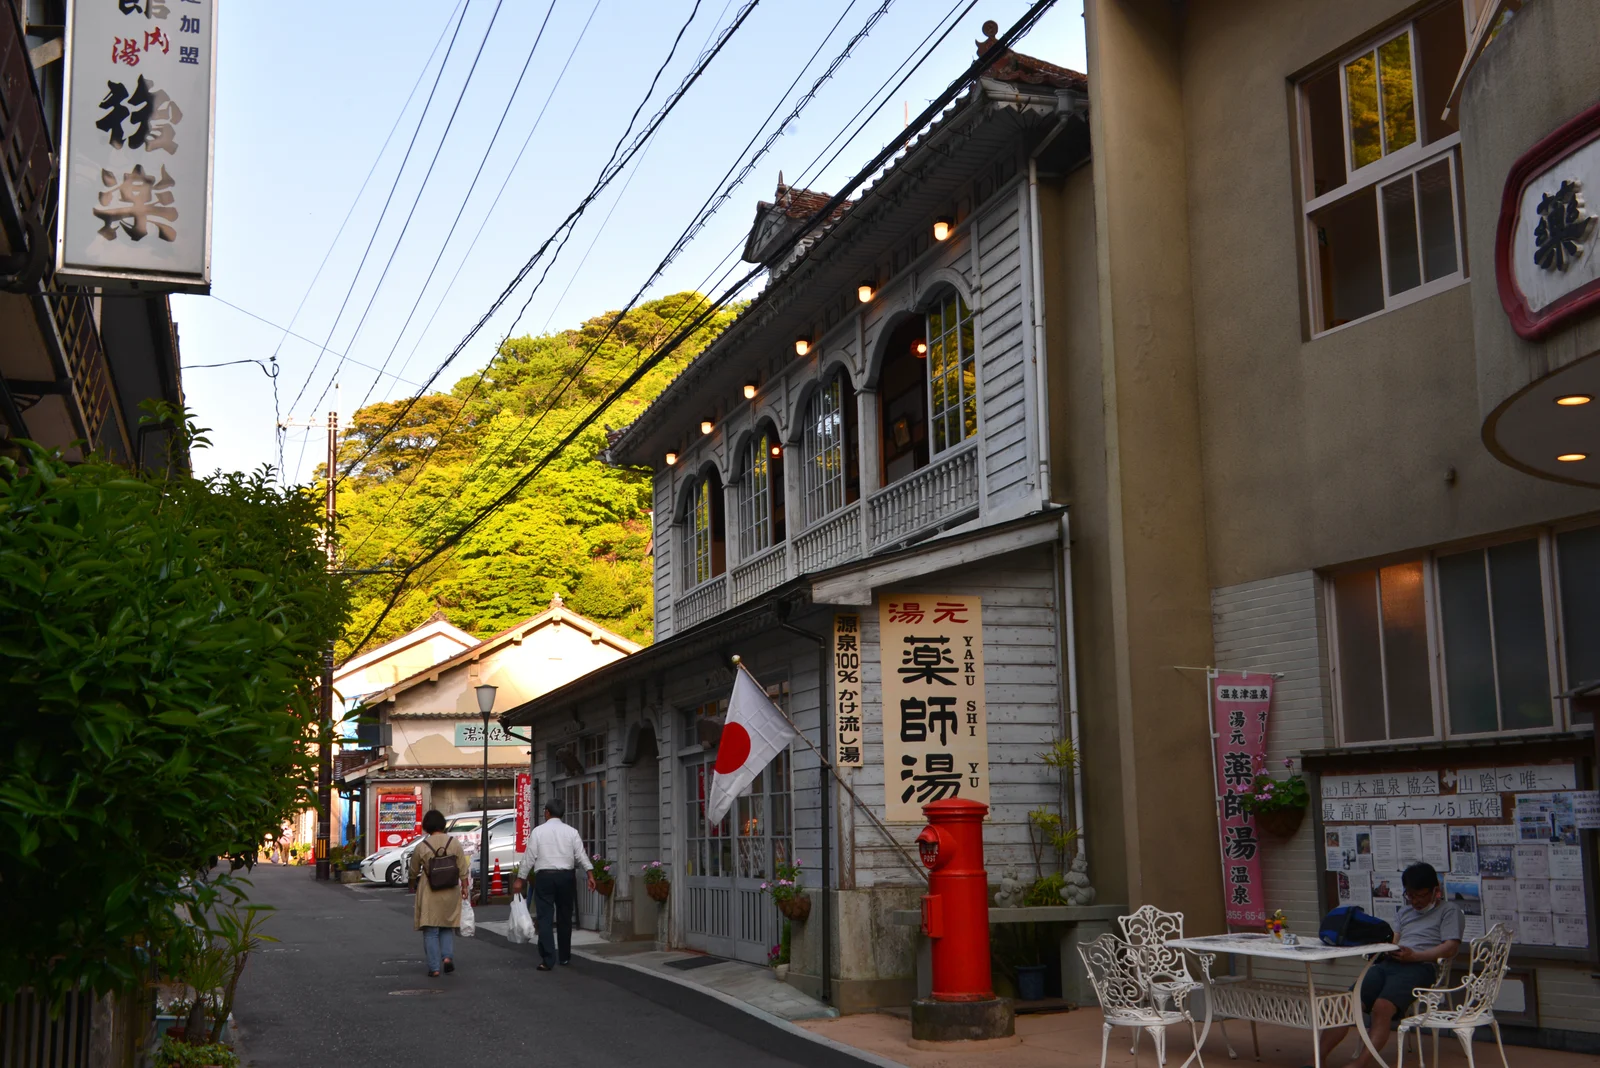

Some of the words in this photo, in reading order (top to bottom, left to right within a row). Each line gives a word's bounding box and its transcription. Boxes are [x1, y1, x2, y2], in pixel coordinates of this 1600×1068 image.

[179, 0, 201, 64] 加盟
[889, 602, 969, 624] 湯元
[963, 636, 976, 686] YAKU
[1220, 688, 1268, 700] 温泉津温泉
[897, 635, 963, 803] 薬師湯
[966, 700, 978, 737] SHI
[1229, 711, 1246, 745] 湯元
[968, 763, 979, 788] YU
[1223, 752, 1257, 861] 薬師湯
[1230, 866, 1251, 904] 温泉
